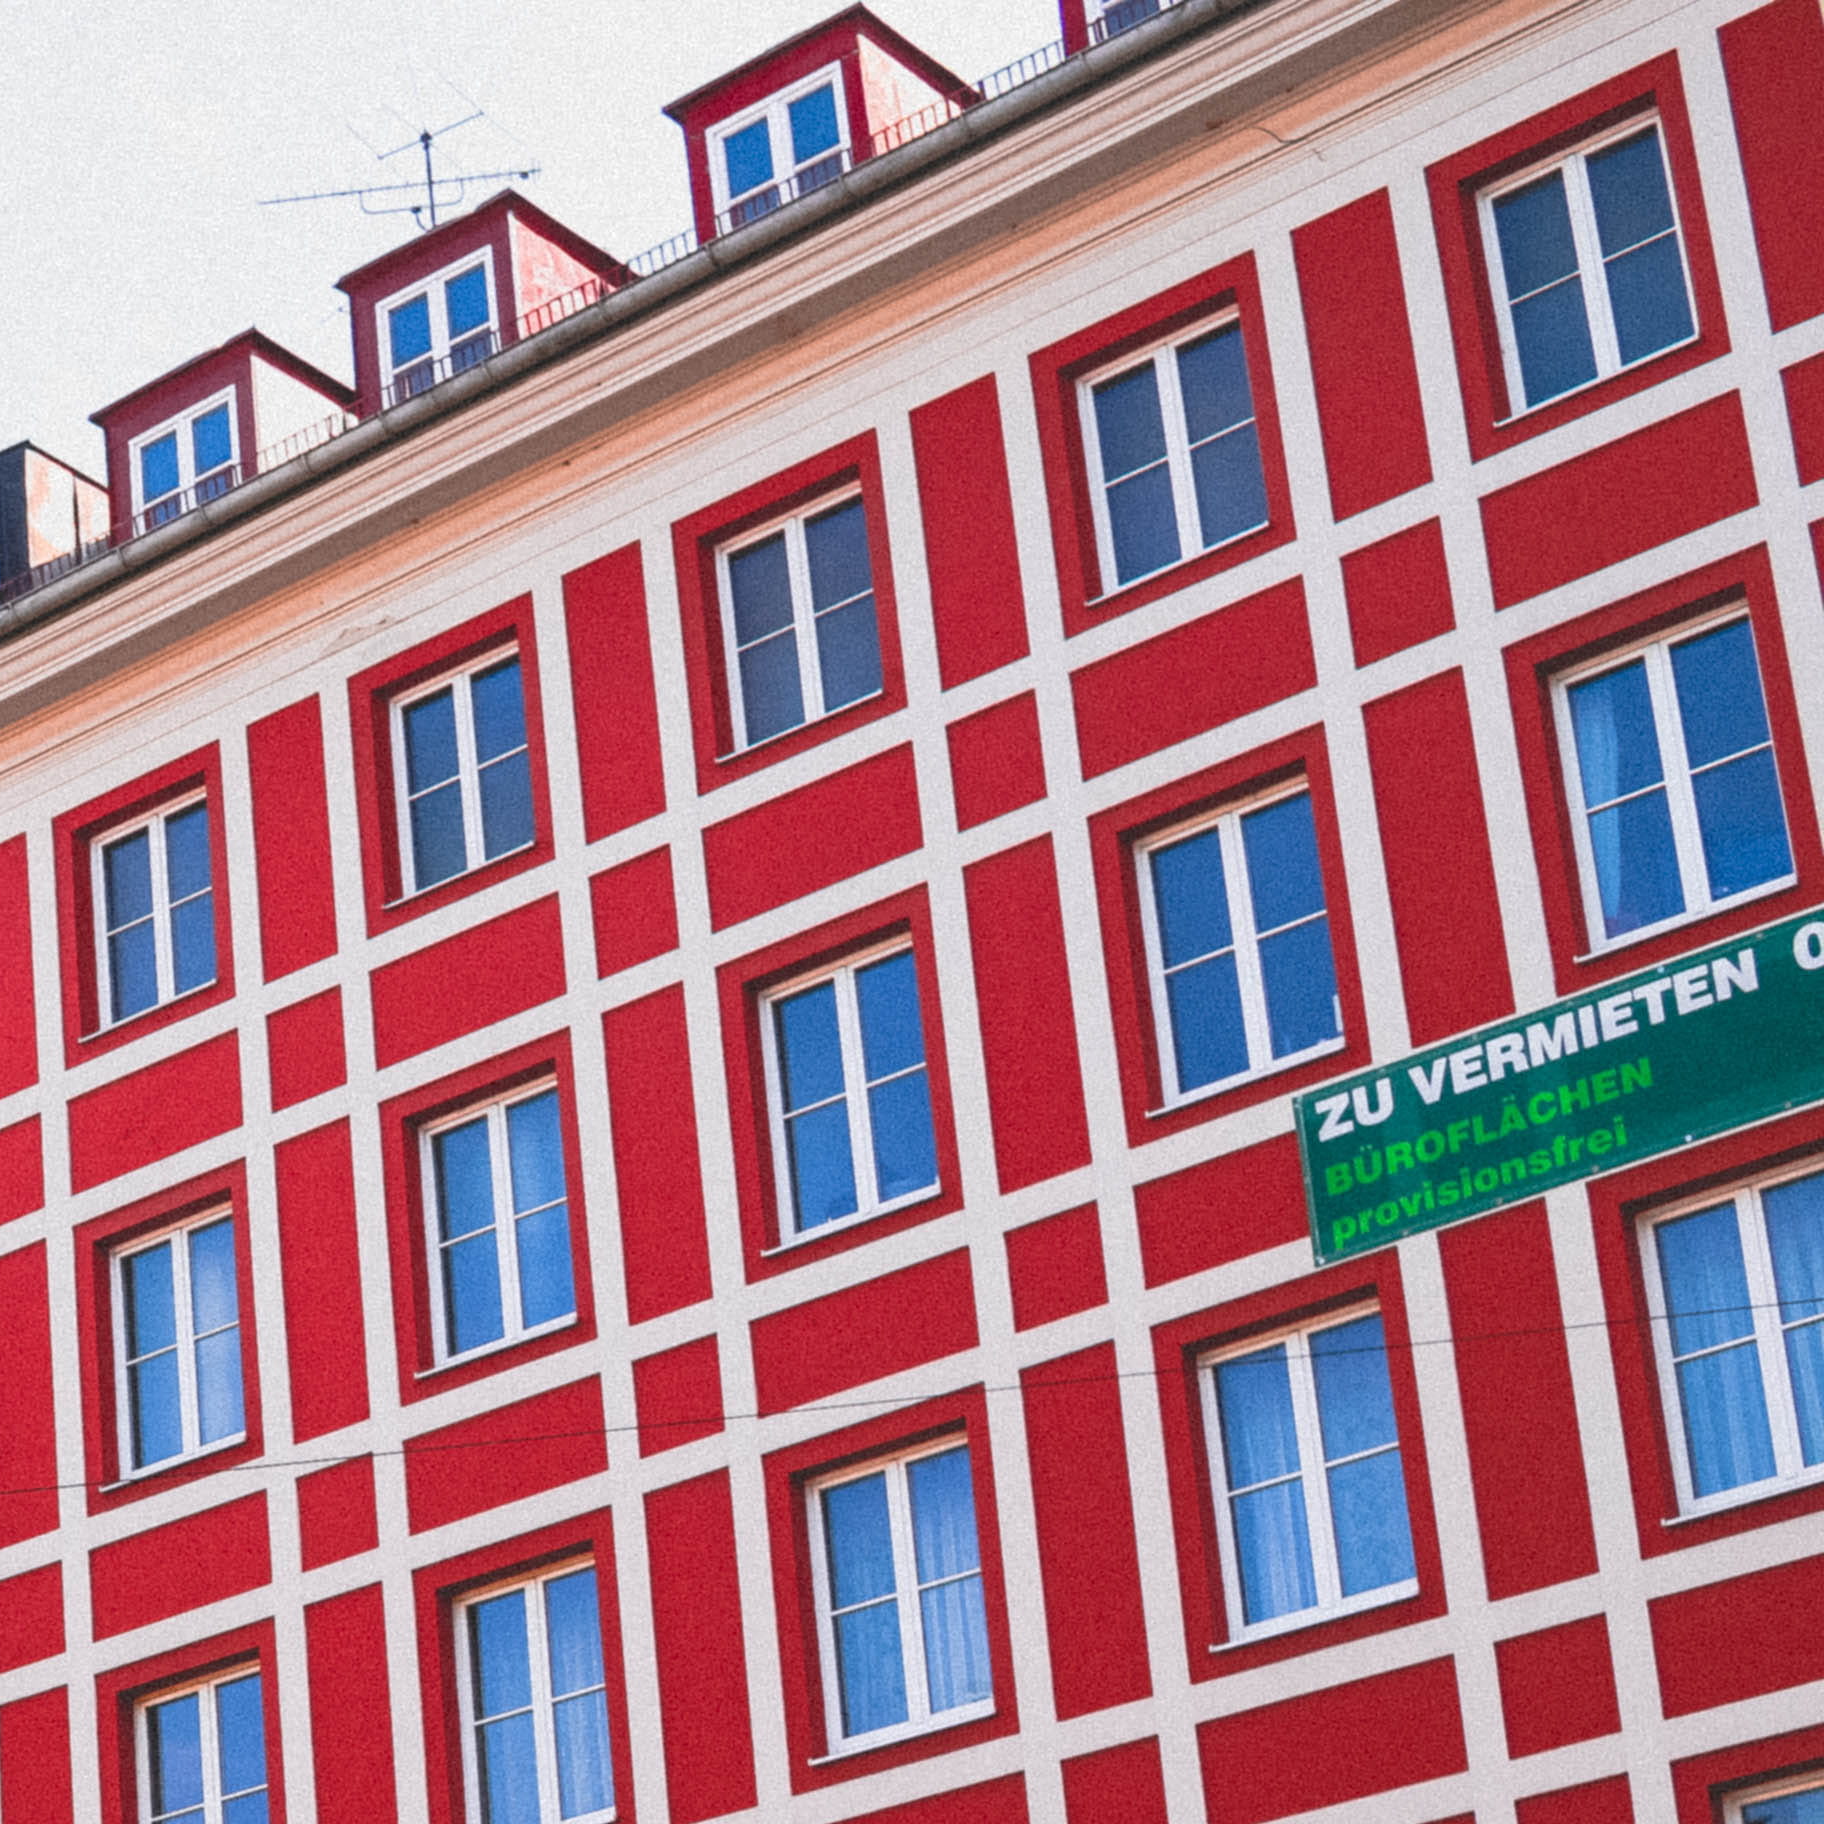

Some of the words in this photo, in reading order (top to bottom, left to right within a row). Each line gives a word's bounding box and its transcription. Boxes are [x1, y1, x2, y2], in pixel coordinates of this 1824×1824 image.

[1314, 1079, 1394, 1143] ZU
[1408, 948, 1759, 1107] VERMIETEN
[1326, 1057, 1653, 1197] BÜROFLÄCHEN
[1332, 1116, 1628, 1249] provisionsfrei
